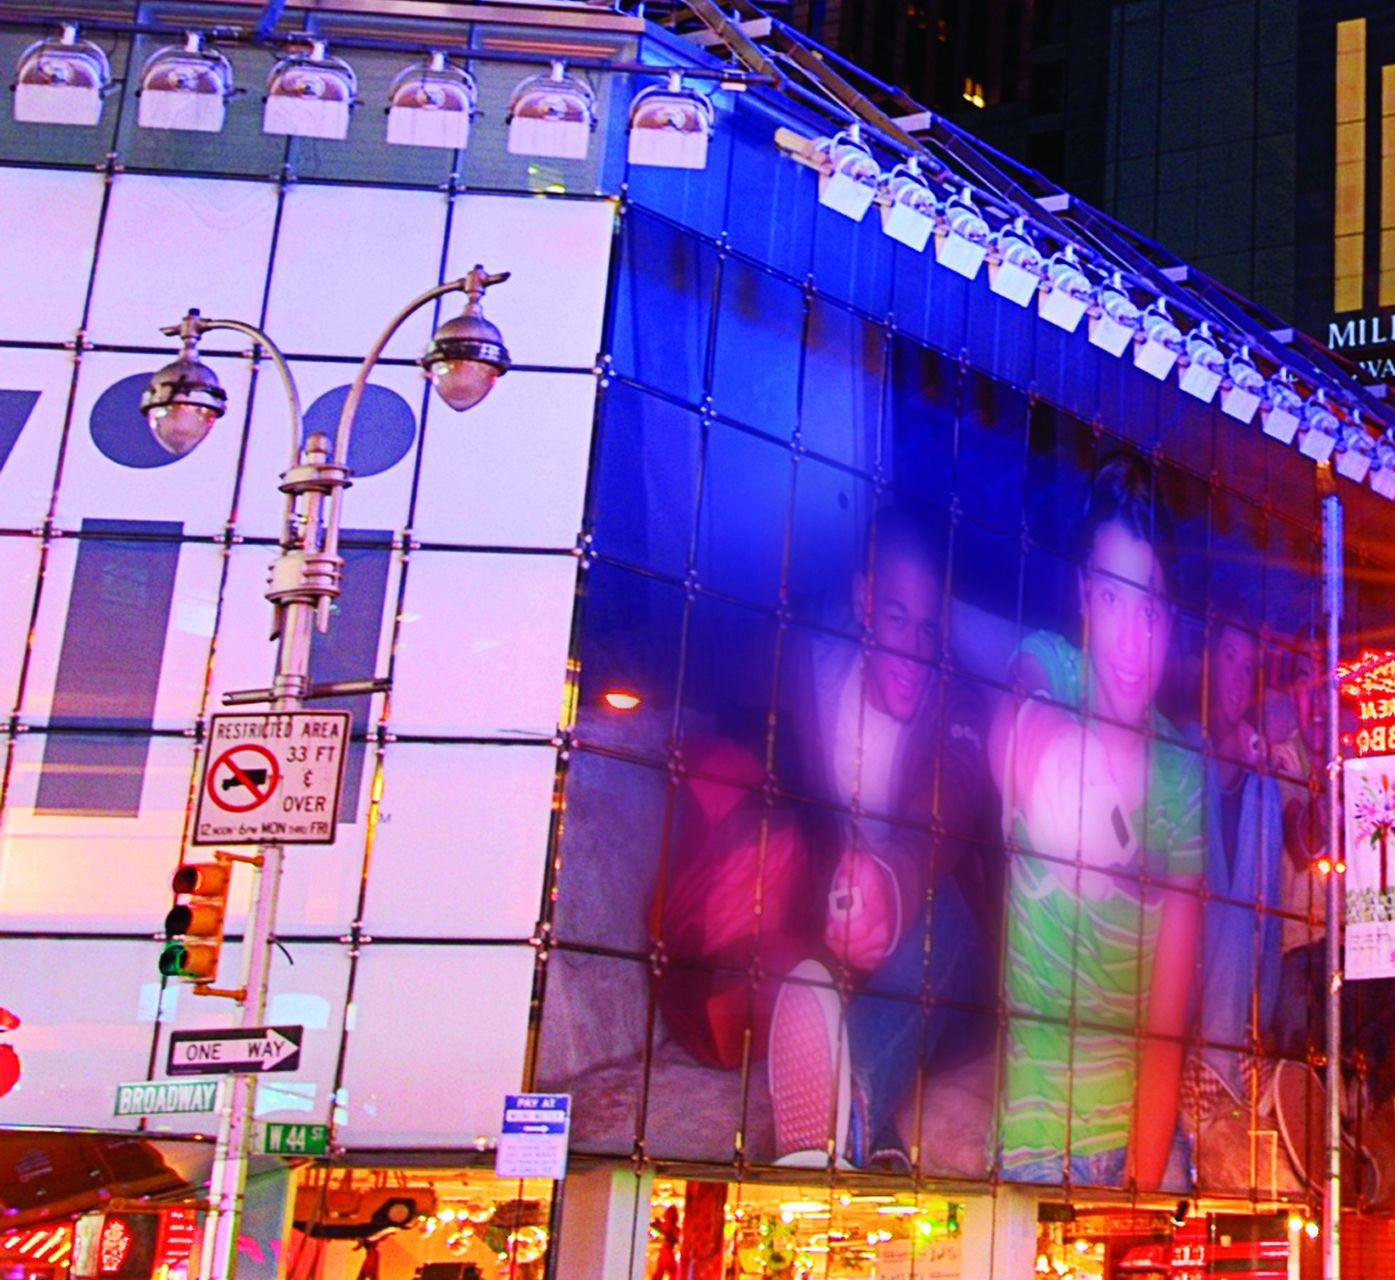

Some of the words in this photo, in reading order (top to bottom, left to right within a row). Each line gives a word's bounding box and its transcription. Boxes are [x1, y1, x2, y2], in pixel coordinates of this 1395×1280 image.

[217, 723, 293, 740] RESTRICTED
[302, 721, 339, 738] AREA
[286, 746, 308, 763] 33
[315, 746, 336, 762] FT
[283, 795, 327, 813] OVER
[261, 822, 286, 834] MON
[310, 820, 329, 834] FRI
[186, 1043, 222, 1061] ONE
[248, 1040, 285, 1059] WAY
[118, 1083, 217, 1115] BROADWAY
[269, 1124, 283, 1151] W
[286, 1125, 306, 1152] 44
